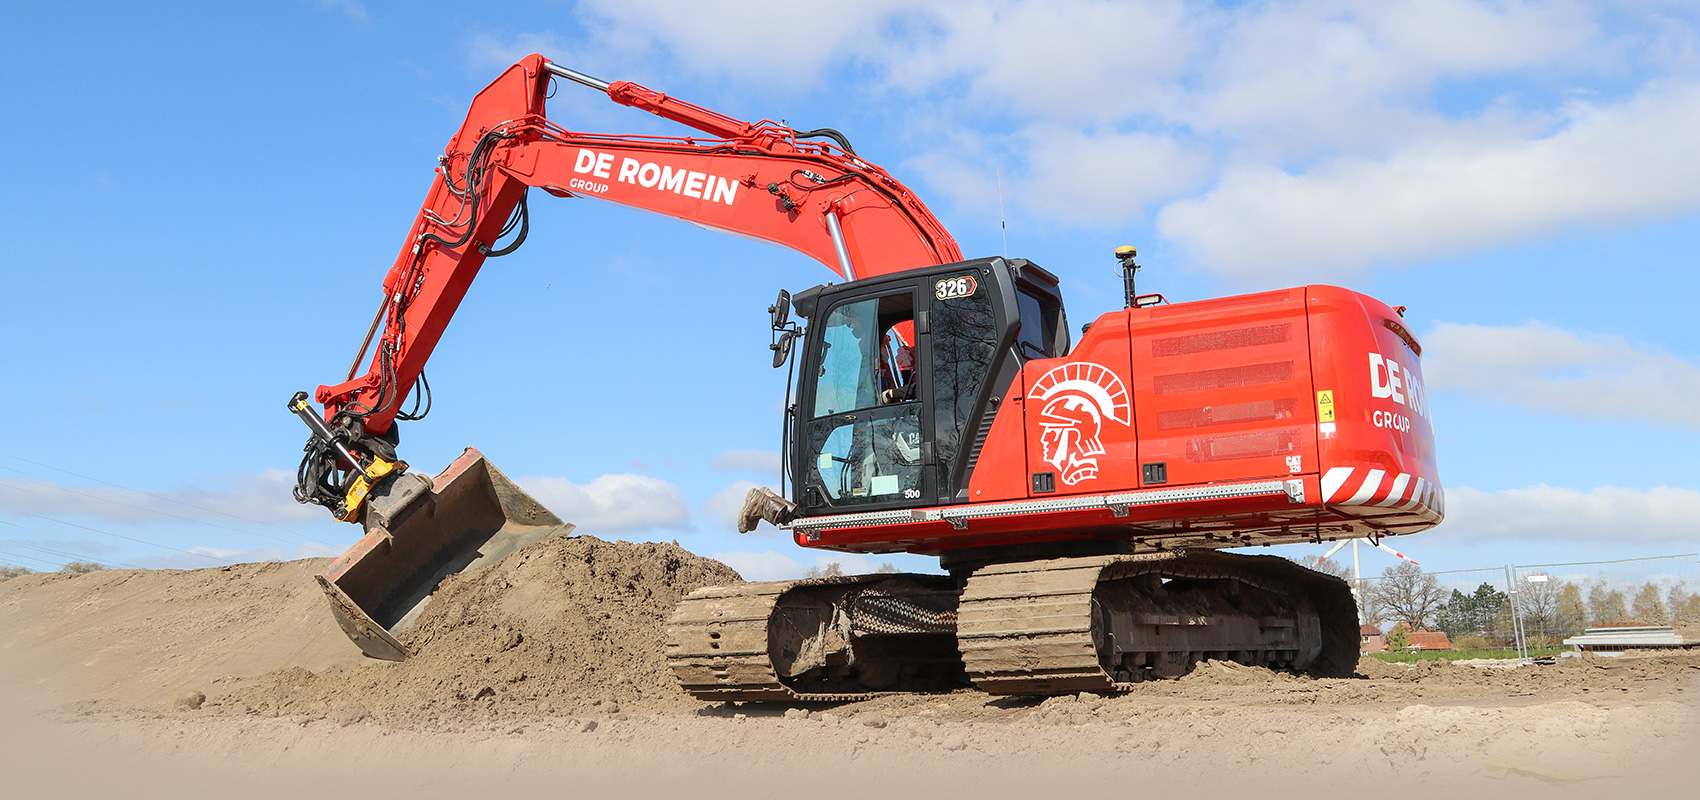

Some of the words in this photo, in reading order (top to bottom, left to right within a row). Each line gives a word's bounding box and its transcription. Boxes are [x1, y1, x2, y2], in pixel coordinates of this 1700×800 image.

[573, 148, 614, 179] DE
[618, 157, 739, 205] ROMEIN
[569, 178, 609, 194] GROUP
[937, 278, 967, 298] 326
[1368, 352, 1405, 405] DE
[1373, 410, 1410, 433] GROUP
[908, 432, 920, 444] CA
[1285, 455, 1302, 466] CAT
[904, 489, 920, 498] 500
